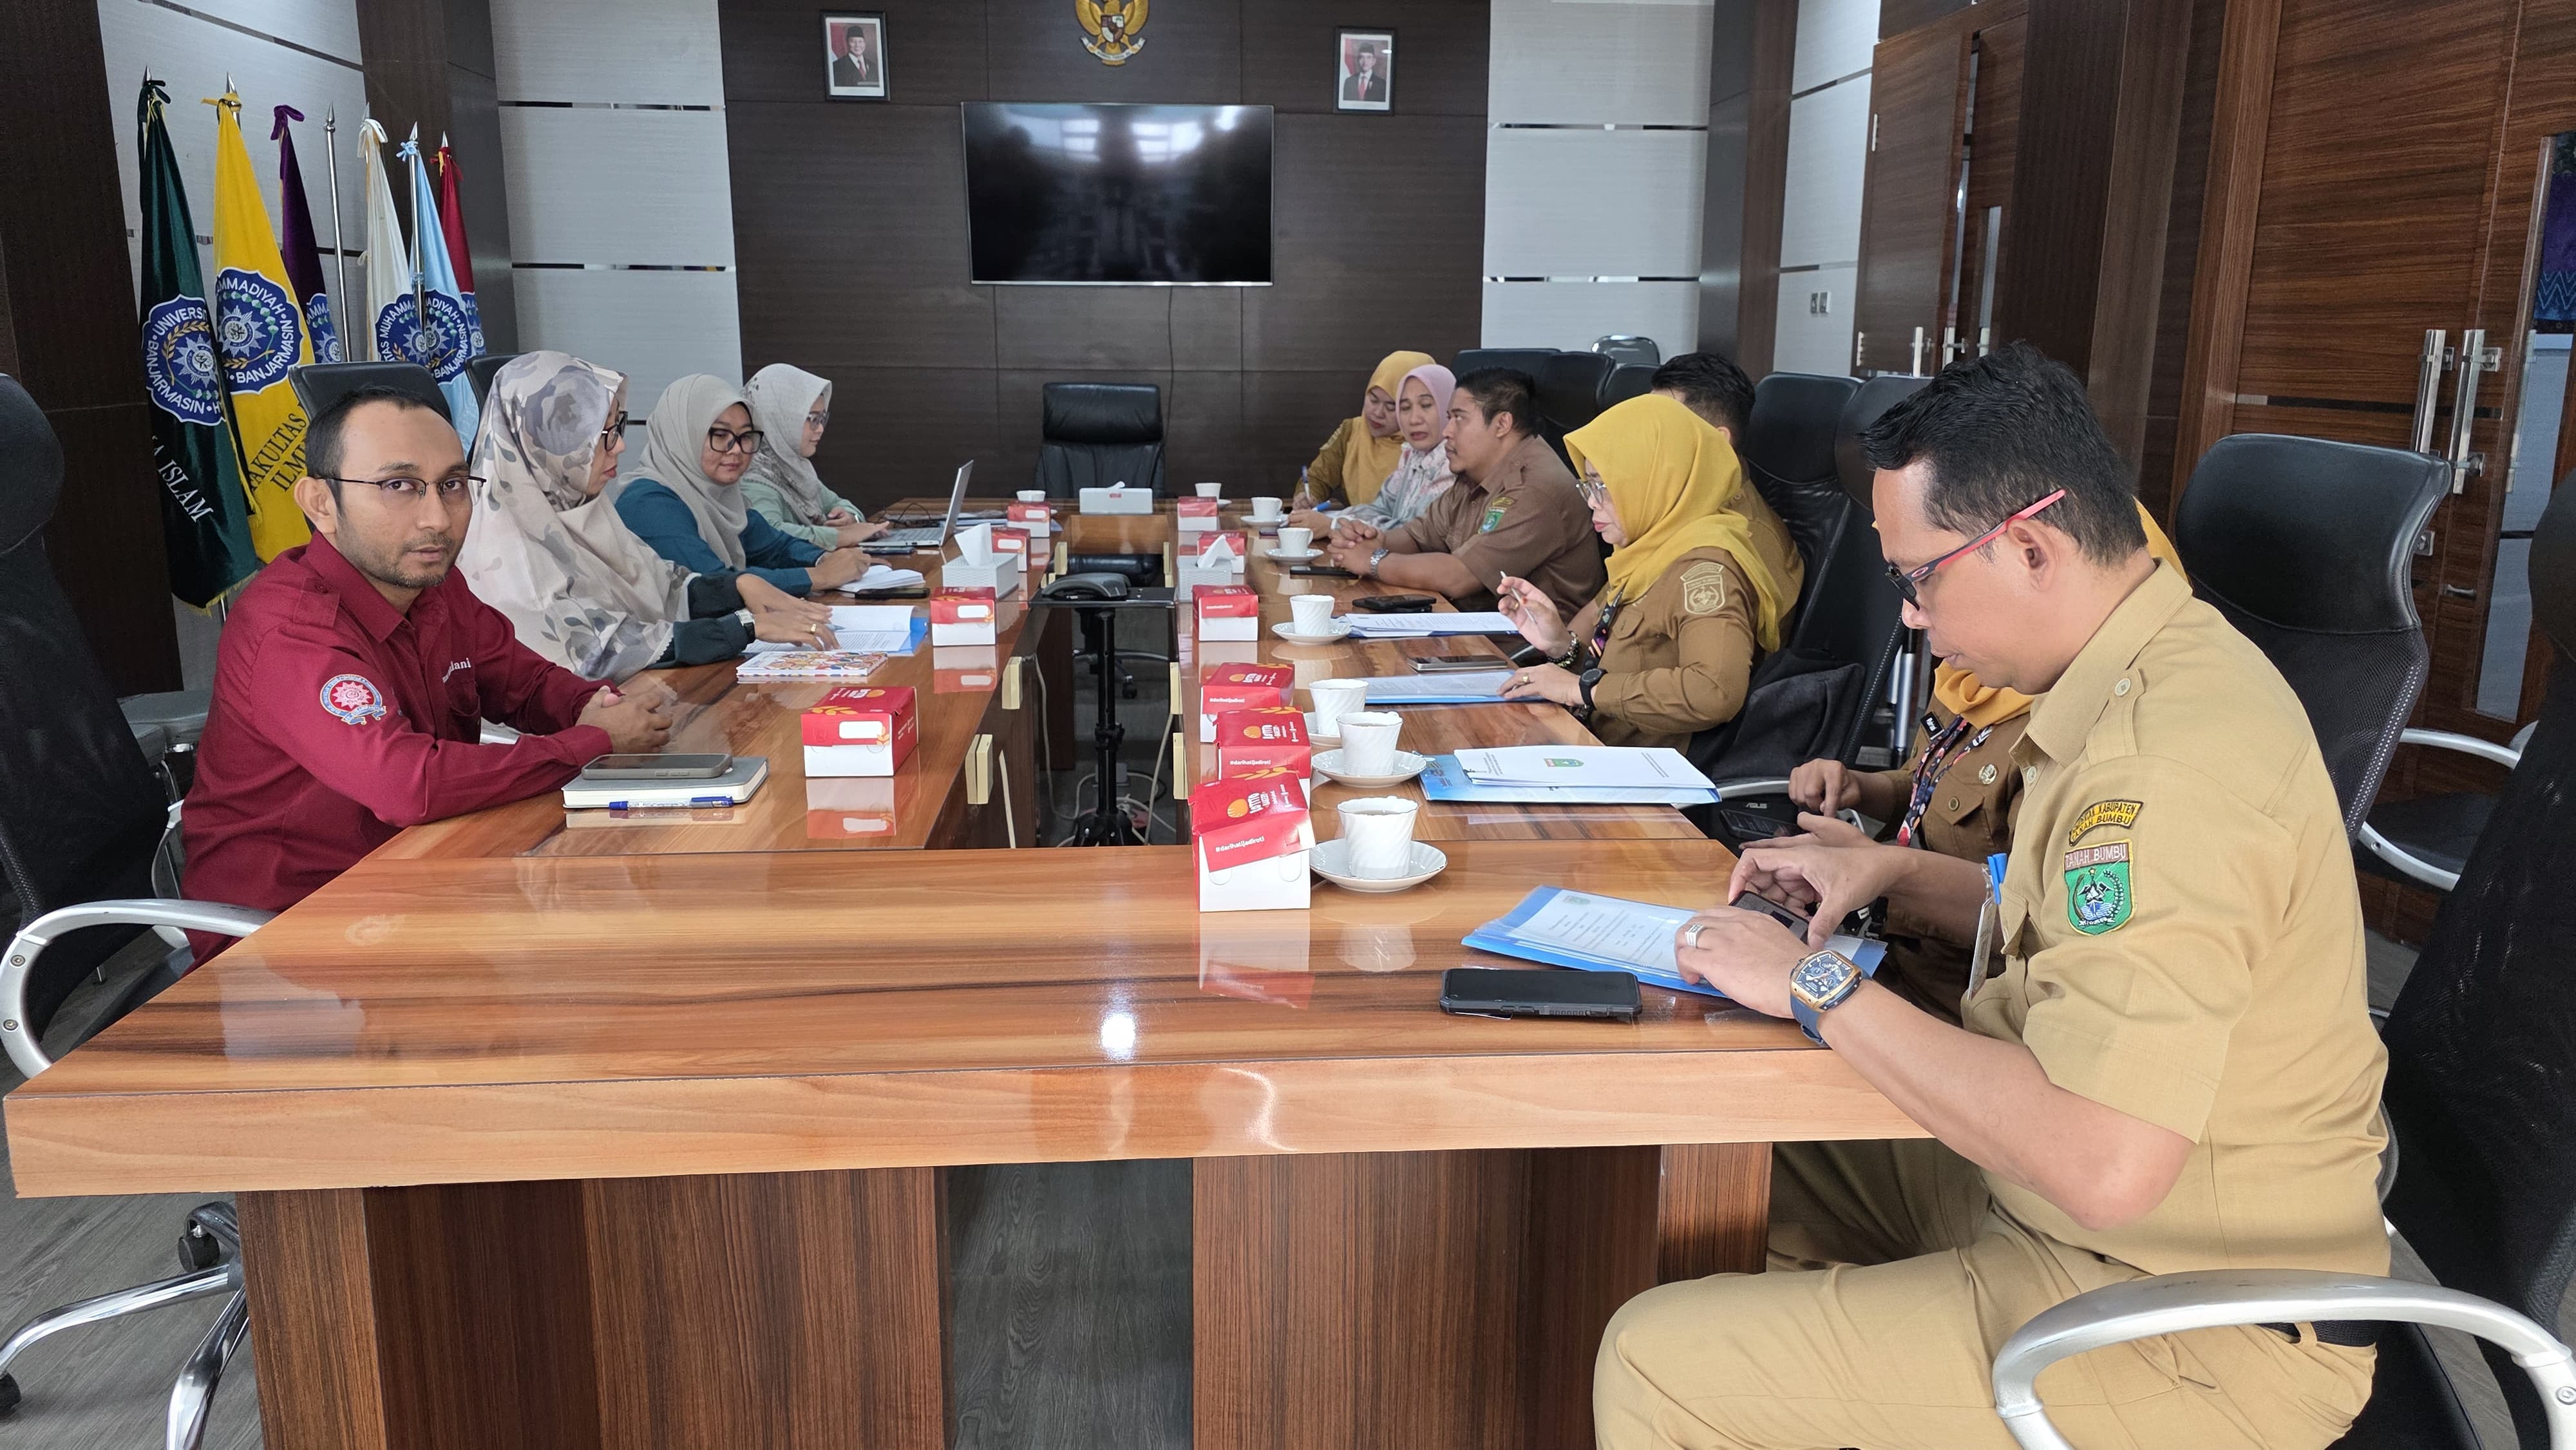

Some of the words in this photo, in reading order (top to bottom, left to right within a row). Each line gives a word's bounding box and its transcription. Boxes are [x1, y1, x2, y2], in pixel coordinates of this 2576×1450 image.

[146, 340, 205, 414] BANJARMASIN
[236, 320, 294, 383] BANJARMASIN
[434, 323, 468, 379] BANJARMASIN
[158, 459, 213, 523] ISLAM
[2096, 814, 2131, 825] BUMBU
[2099, 802, 2136, 816] KABUPATEN
[2065, 849, 2090, 869] TANAH
[2093, 843, 2126, 862] BUMBU
